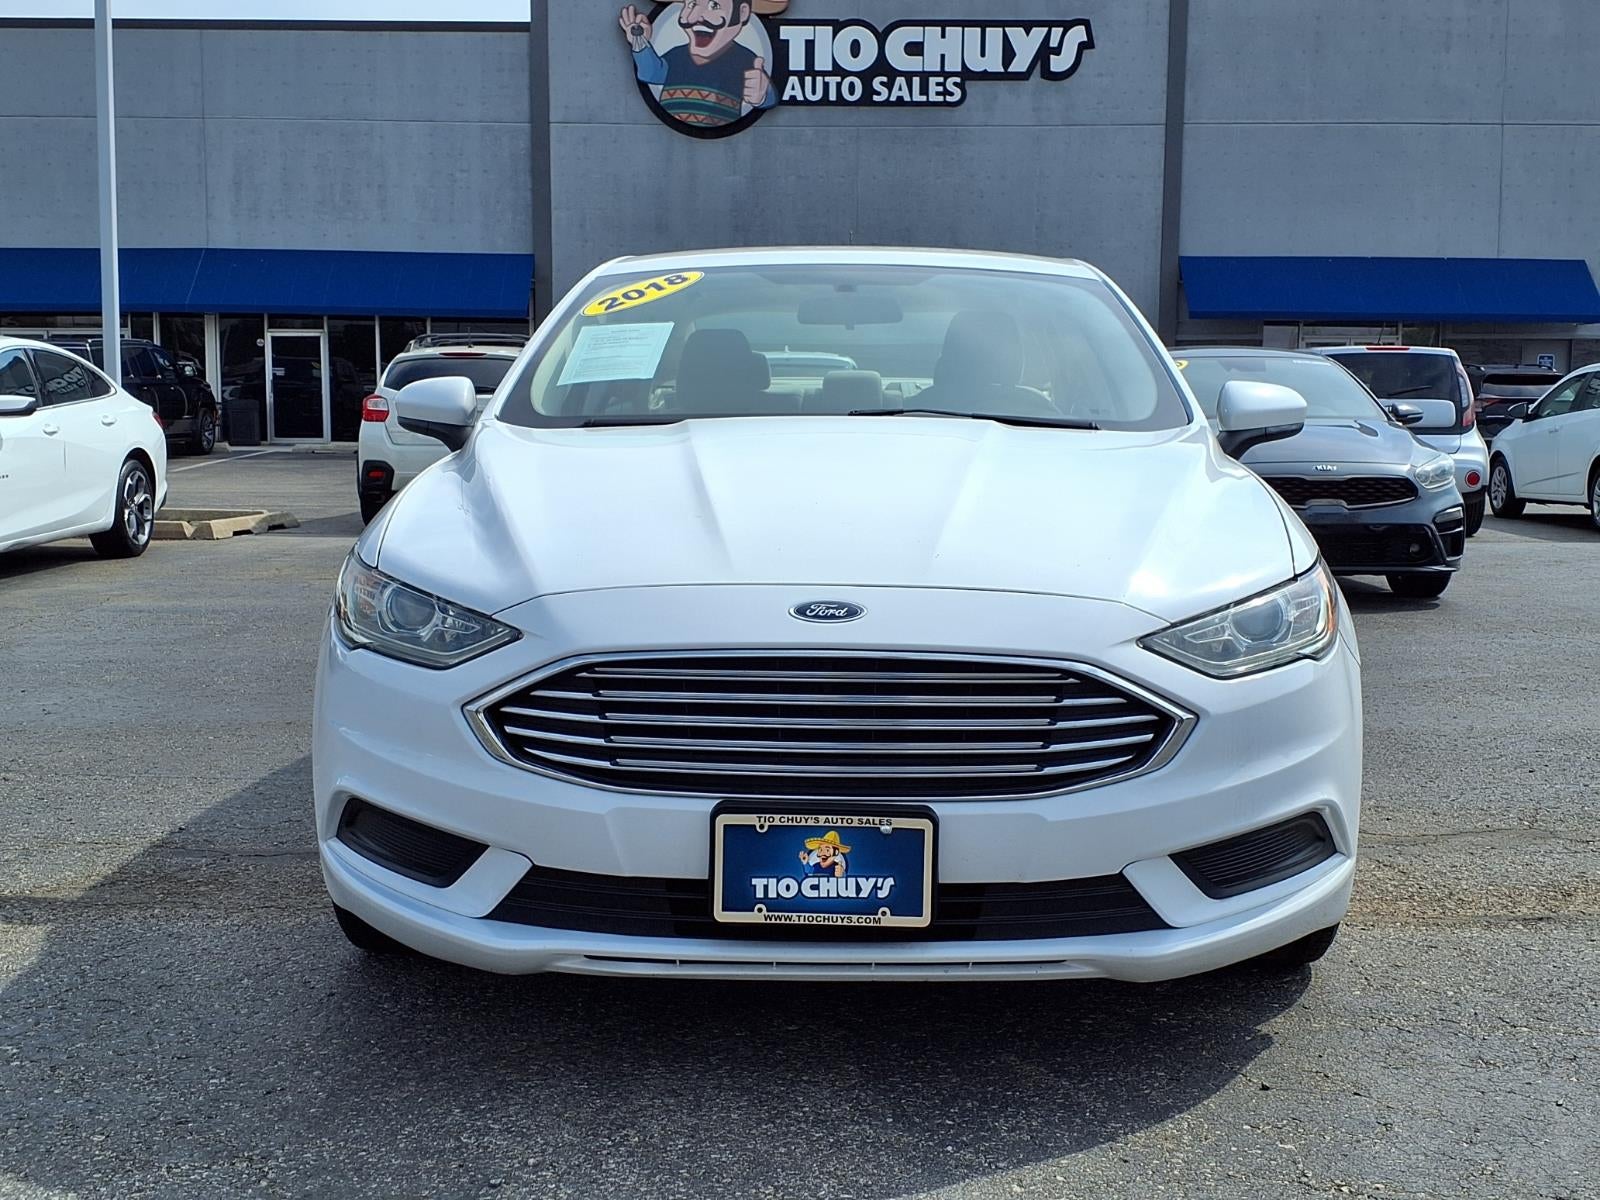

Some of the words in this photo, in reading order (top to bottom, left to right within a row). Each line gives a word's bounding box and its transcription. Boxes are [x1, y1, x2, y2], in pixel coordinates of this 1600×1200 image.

[779, 25, 879, 72] TIO
[885, 25, 1088, 72] CHUY'S
[783, 76, 863, 102] AUTO
[872, 76, 962, 102] SALES
[597, 273, 689, 312] 2018
[805, 603, 849, 617] Ford
[756, 815, 775, 824] TIO
[778, 815, 820, 825] CHUY'S
[823, 816, 854, 825] AUTO
[857, 817, 893, 826] SALES
[751, 877, 799, 899] TIO
[800, 877, 895, 899] CHUY'S
[763, 913, 882, 926] WWW.TIOCHUYS.COM
